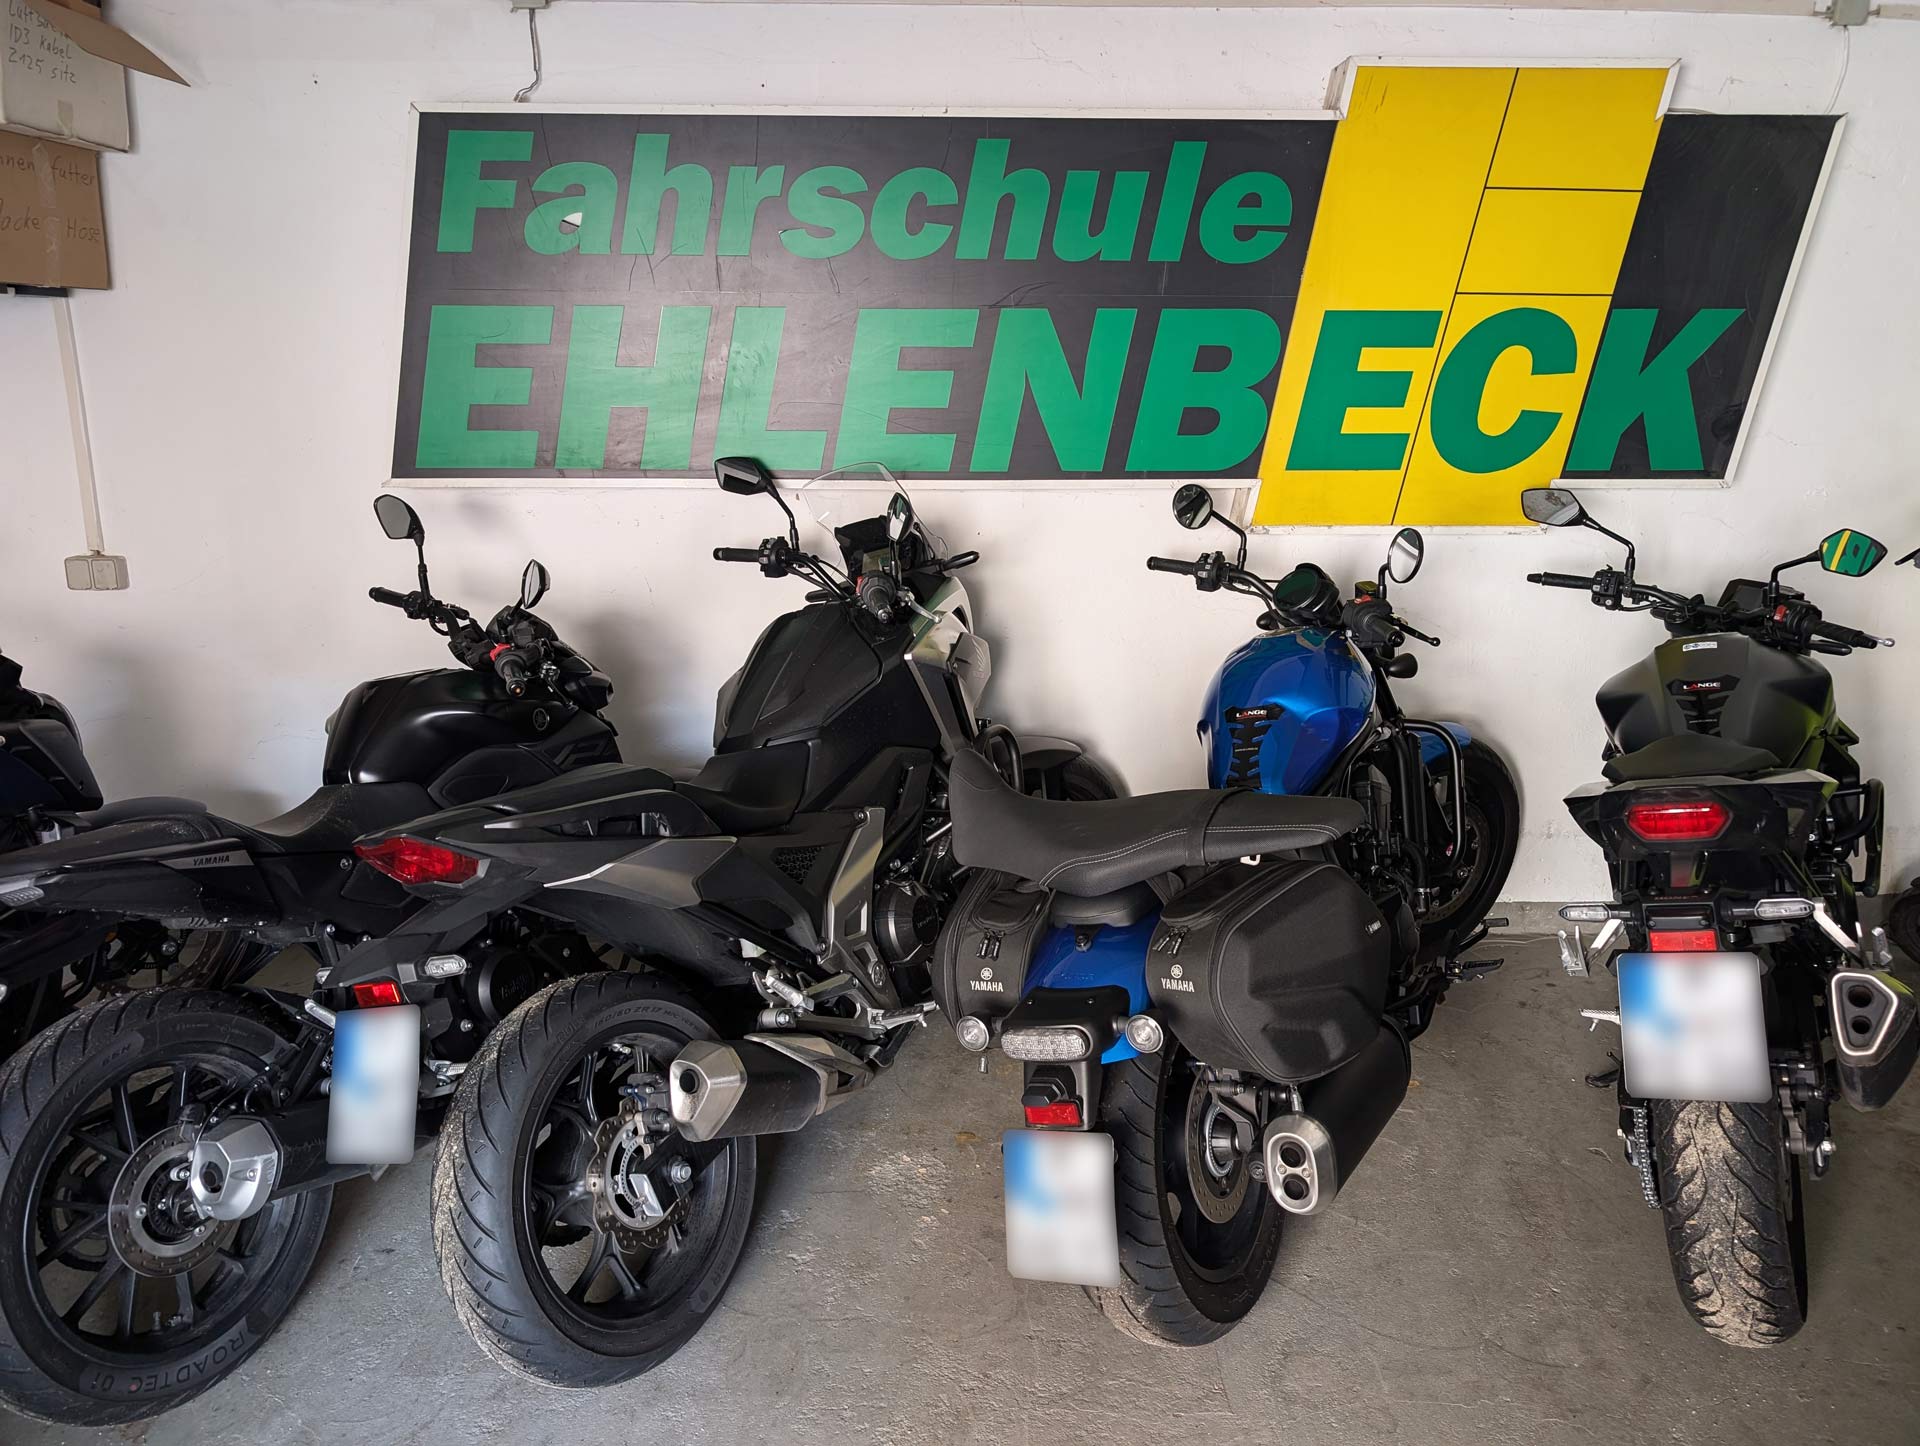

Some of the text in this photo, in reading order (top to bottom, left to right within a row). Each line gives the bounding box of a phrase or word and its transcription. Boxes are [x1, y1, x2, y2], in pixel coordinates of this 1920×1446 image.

[436, 130, 1293, 264] Fahrschule
[416, 305, 1746, 474] EHLENBECK
[1683, 681, 1721, 690] LANGE
[193, 855, 230, 867] YAMAHA
[970, 980, 1004, 993] YAMAHA
[1160, 977, 1195, 993] YAMAHA
[128, 1330, 246, 1394] ROADTEC
